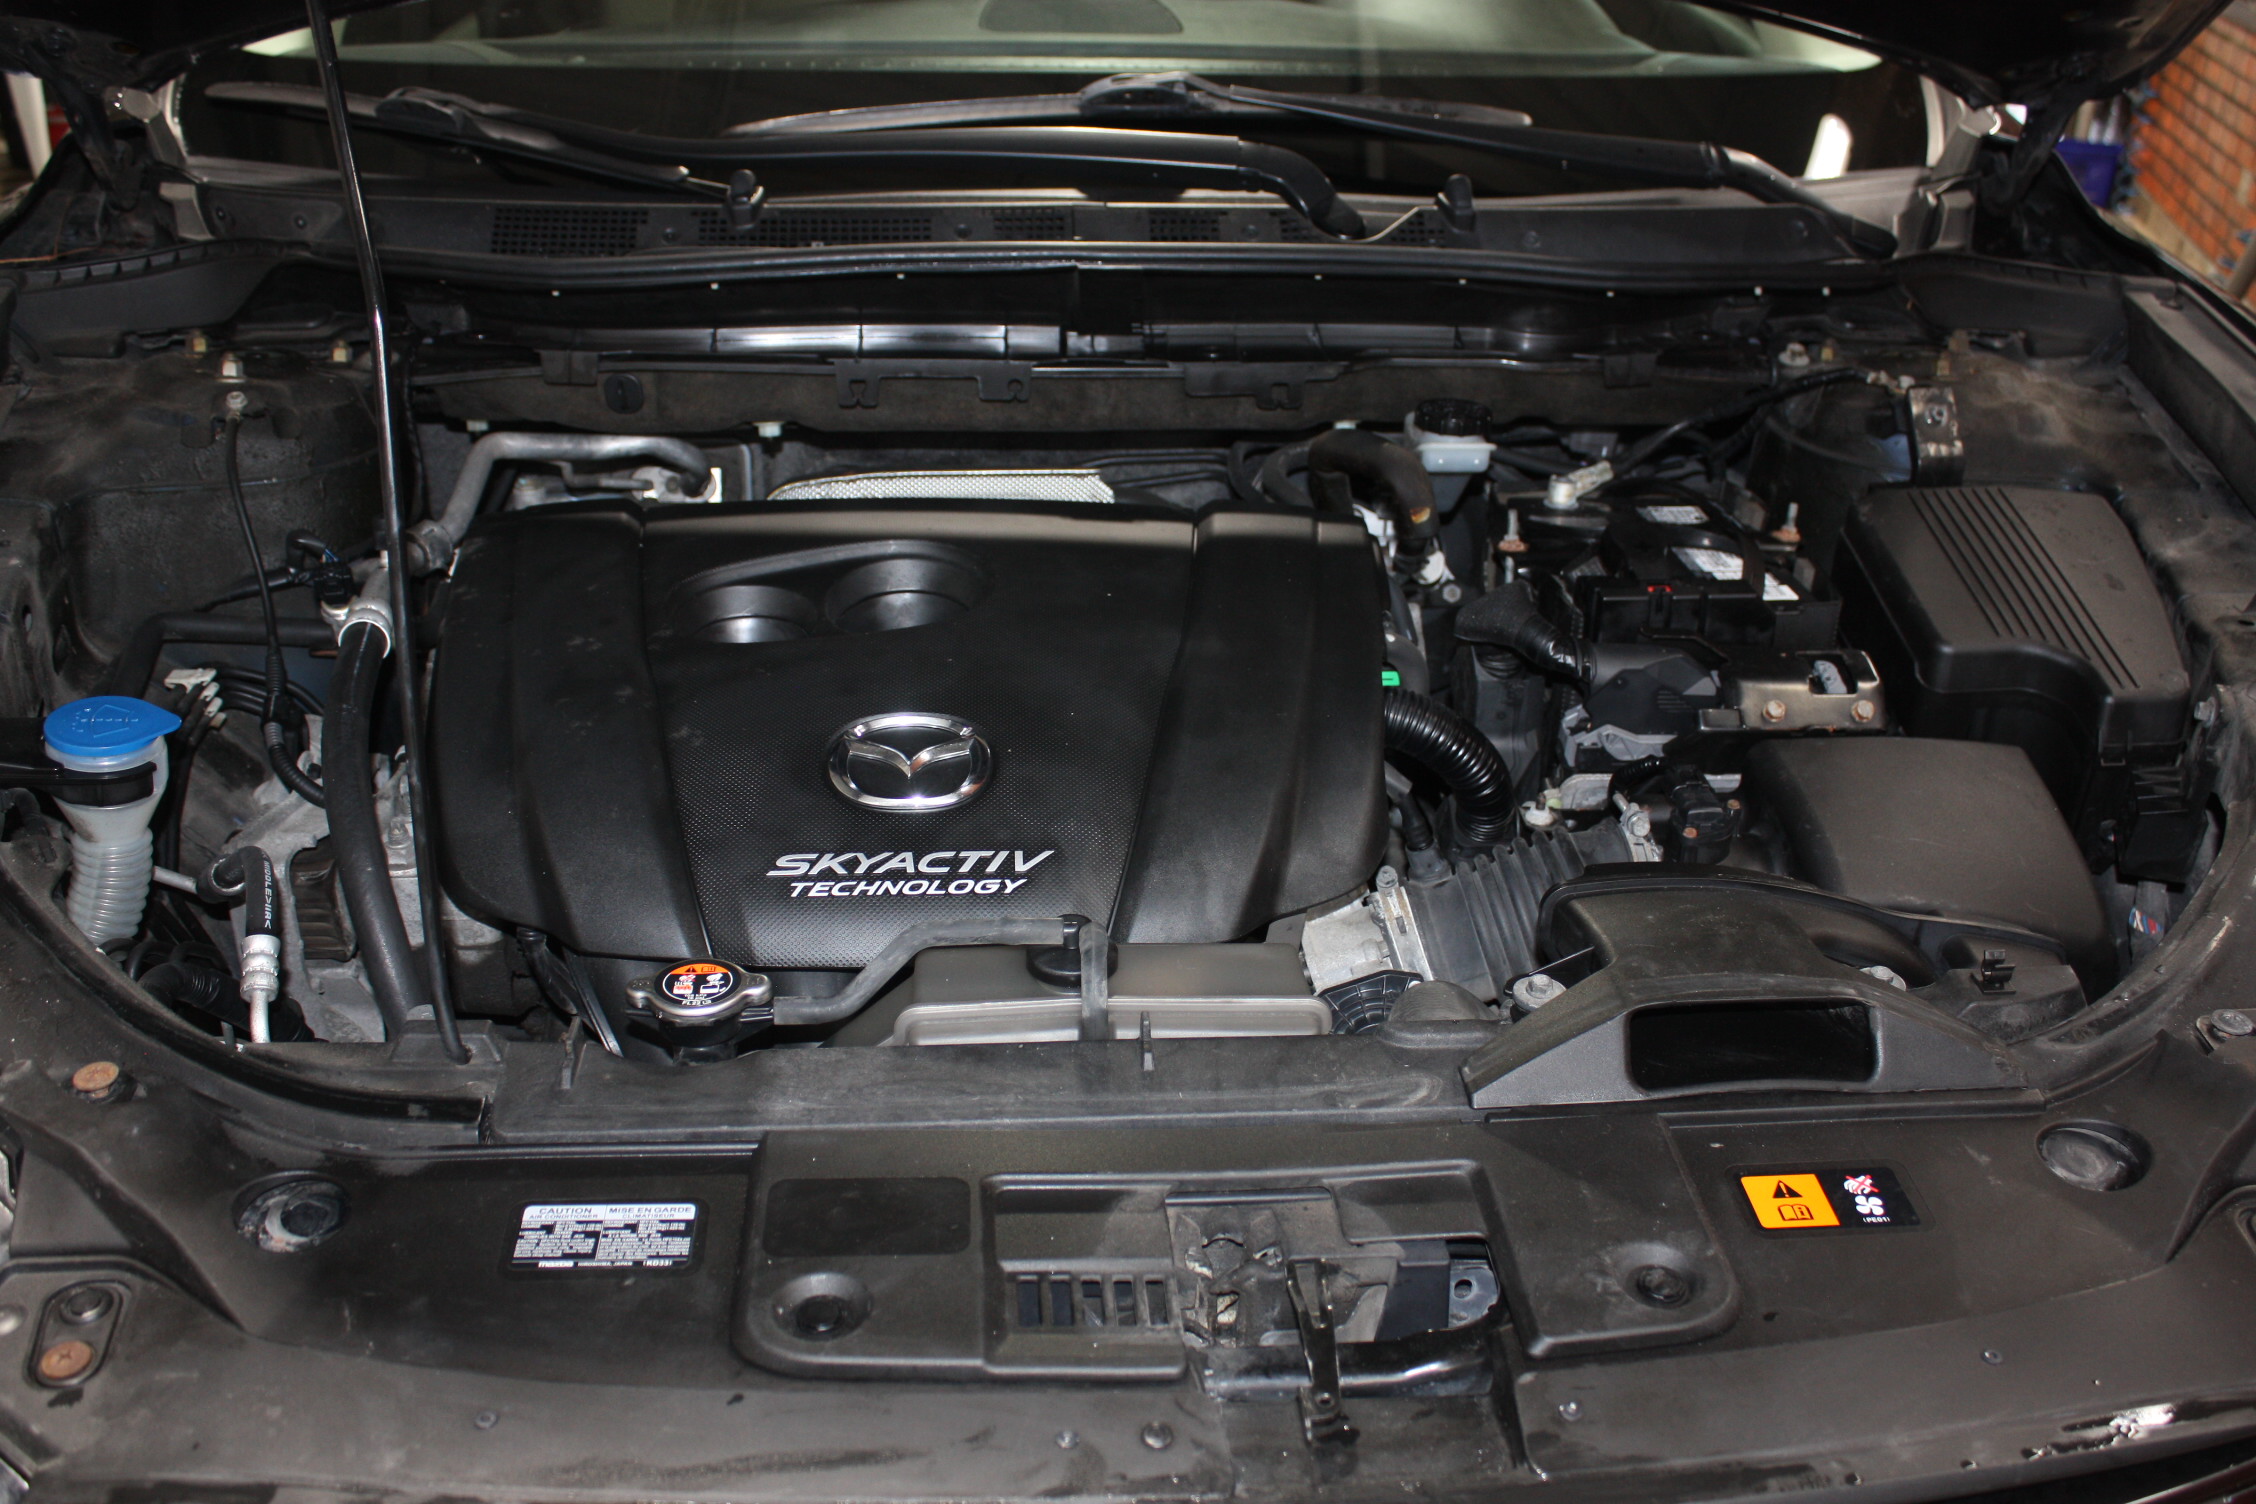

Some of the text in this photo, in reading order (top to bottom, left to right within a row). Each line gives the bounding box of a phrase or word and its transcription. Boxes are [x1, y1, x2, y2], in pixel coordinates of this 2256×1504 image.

[766, 850, 1055, 877] SKYACTIV
[790, 878, 1028, 898] TECHNOLOGY
[539, 1207, 592, 1215] CAUTION
